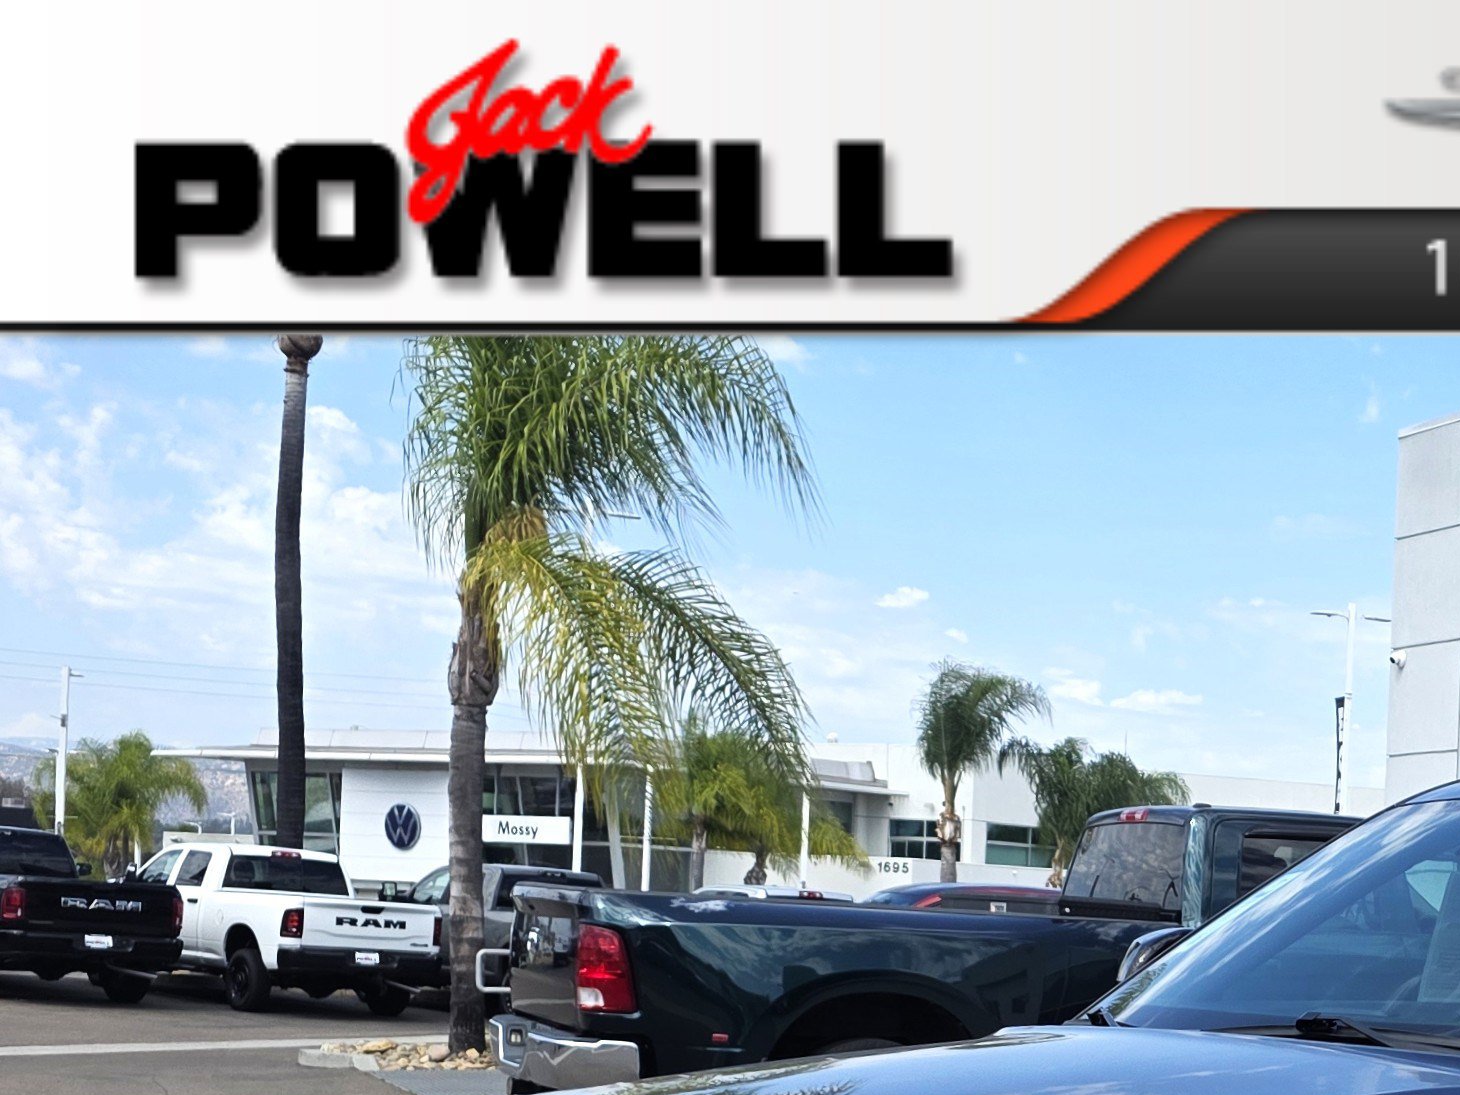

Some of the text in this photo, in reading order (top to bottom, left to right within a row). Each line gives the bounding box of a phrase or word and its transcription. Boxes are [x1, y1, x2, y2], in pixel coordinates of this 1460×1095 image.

[498, 821, 539, 839] Mossy
[877, 862, 910, 874] 1695
[61, 896, 142, 911] RAM
[335, 916, 407, 930] RAM
